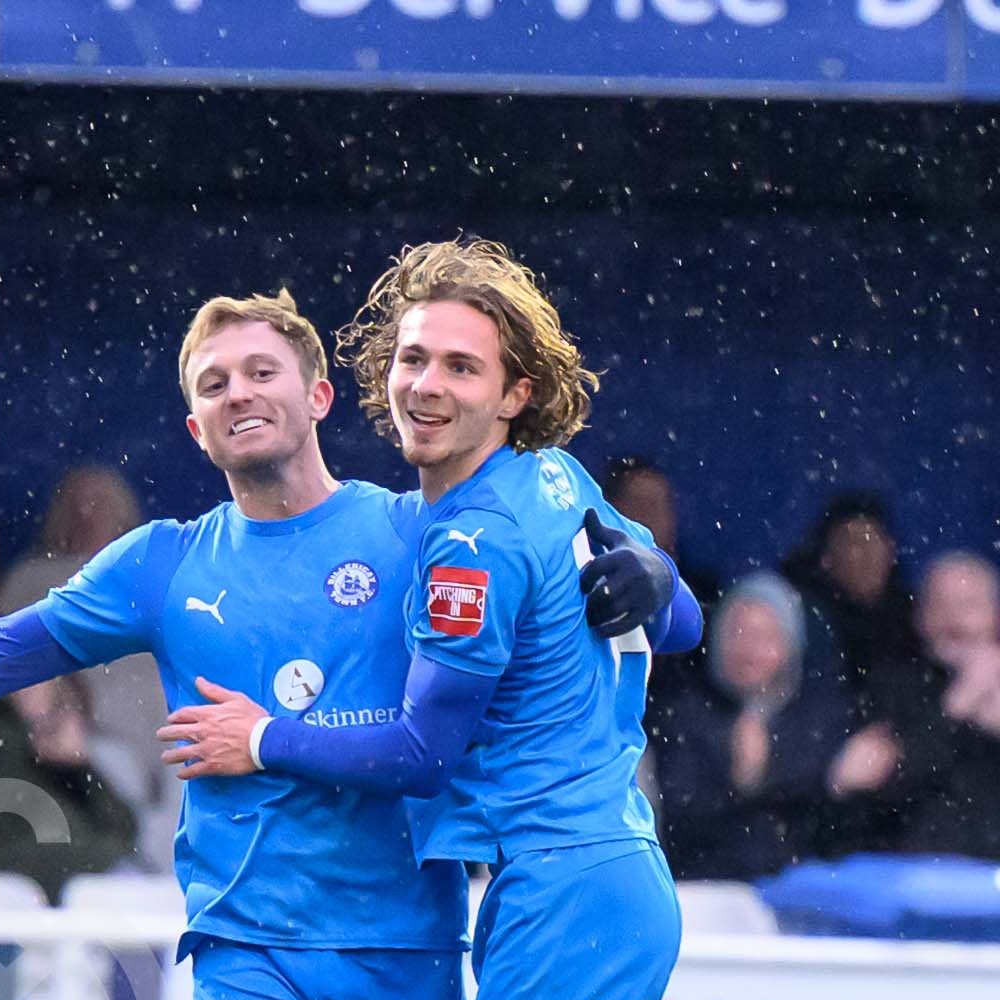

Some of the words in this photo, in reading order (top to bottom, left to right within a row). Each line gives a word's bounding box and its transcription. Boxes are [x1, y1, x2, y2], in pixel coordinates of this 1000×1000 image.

[433, 586, 477, 604] PITCHING
[450, 601, 461, 617] IN
[303, 707, 398, 728] Skinner
